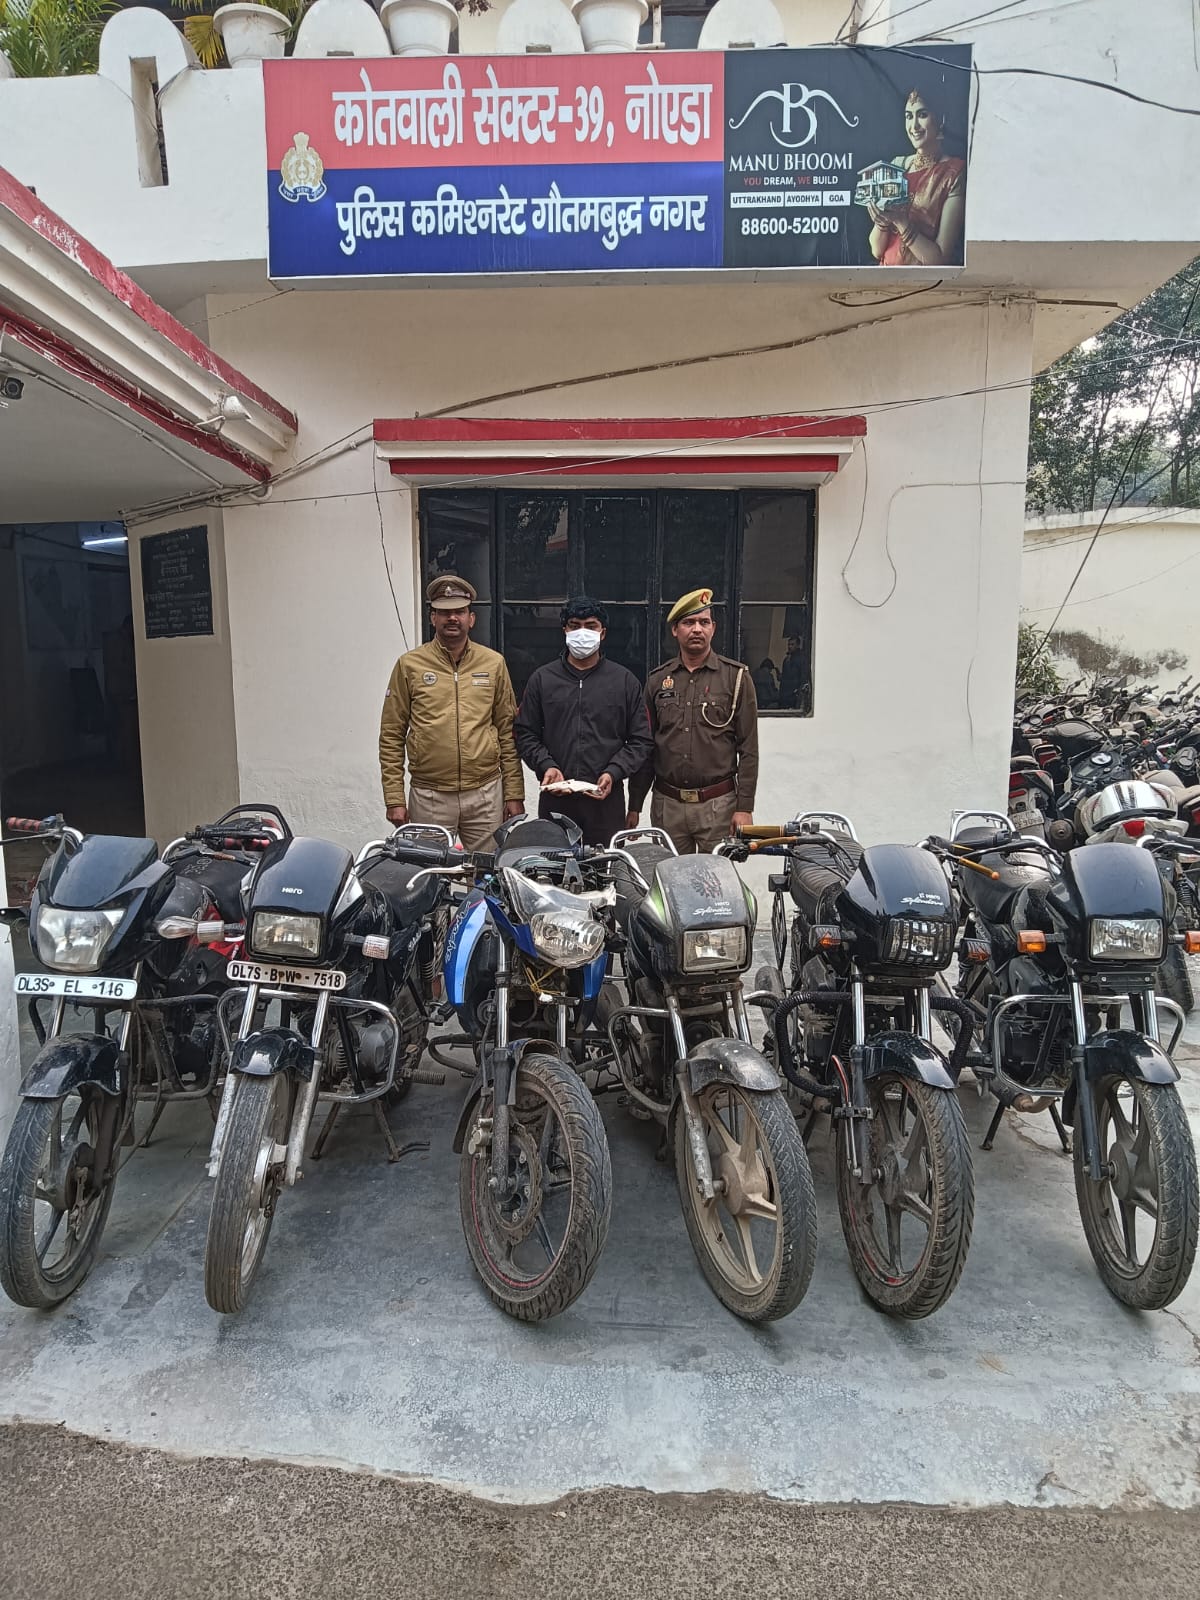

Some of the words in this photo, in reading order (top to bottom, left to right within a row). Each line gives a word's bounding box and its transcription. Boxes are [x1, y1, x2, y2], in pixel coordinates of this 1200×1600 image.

[332, 62, 465, 148] कोतवाली
[625, 61, 713, 146] नोएडा
[729, 153, 780, 172] MANU
[784, 152, 853, 171] BHOOMI
[744, 177, 761, 186] YOU
[763, 176, 796, 188] DREAM,
[798, 176, 811, 185] WE
[812, 175, 839, 185] BUILD
[732, 195, 782, 204] UTTRAKHAND
[786, 194, 820, 203] AYODHYA
[829, 194, 845, 202] GOA
[335, 185, 406, 256] पुलिस
[410, 183, 528, 236] कमिश्नरेट
[531, 180, 645, 251] गौतमबुद्ध
[648, 195, 709, 232] नगर
[741, 216, 840, 236] 88600-52000
[17, 976, 50, 992] DL3S
[63, 979, 83, 994] EL
[231, 964, 262, 980] DL7S
[313, 972, 342, 988] 7518
